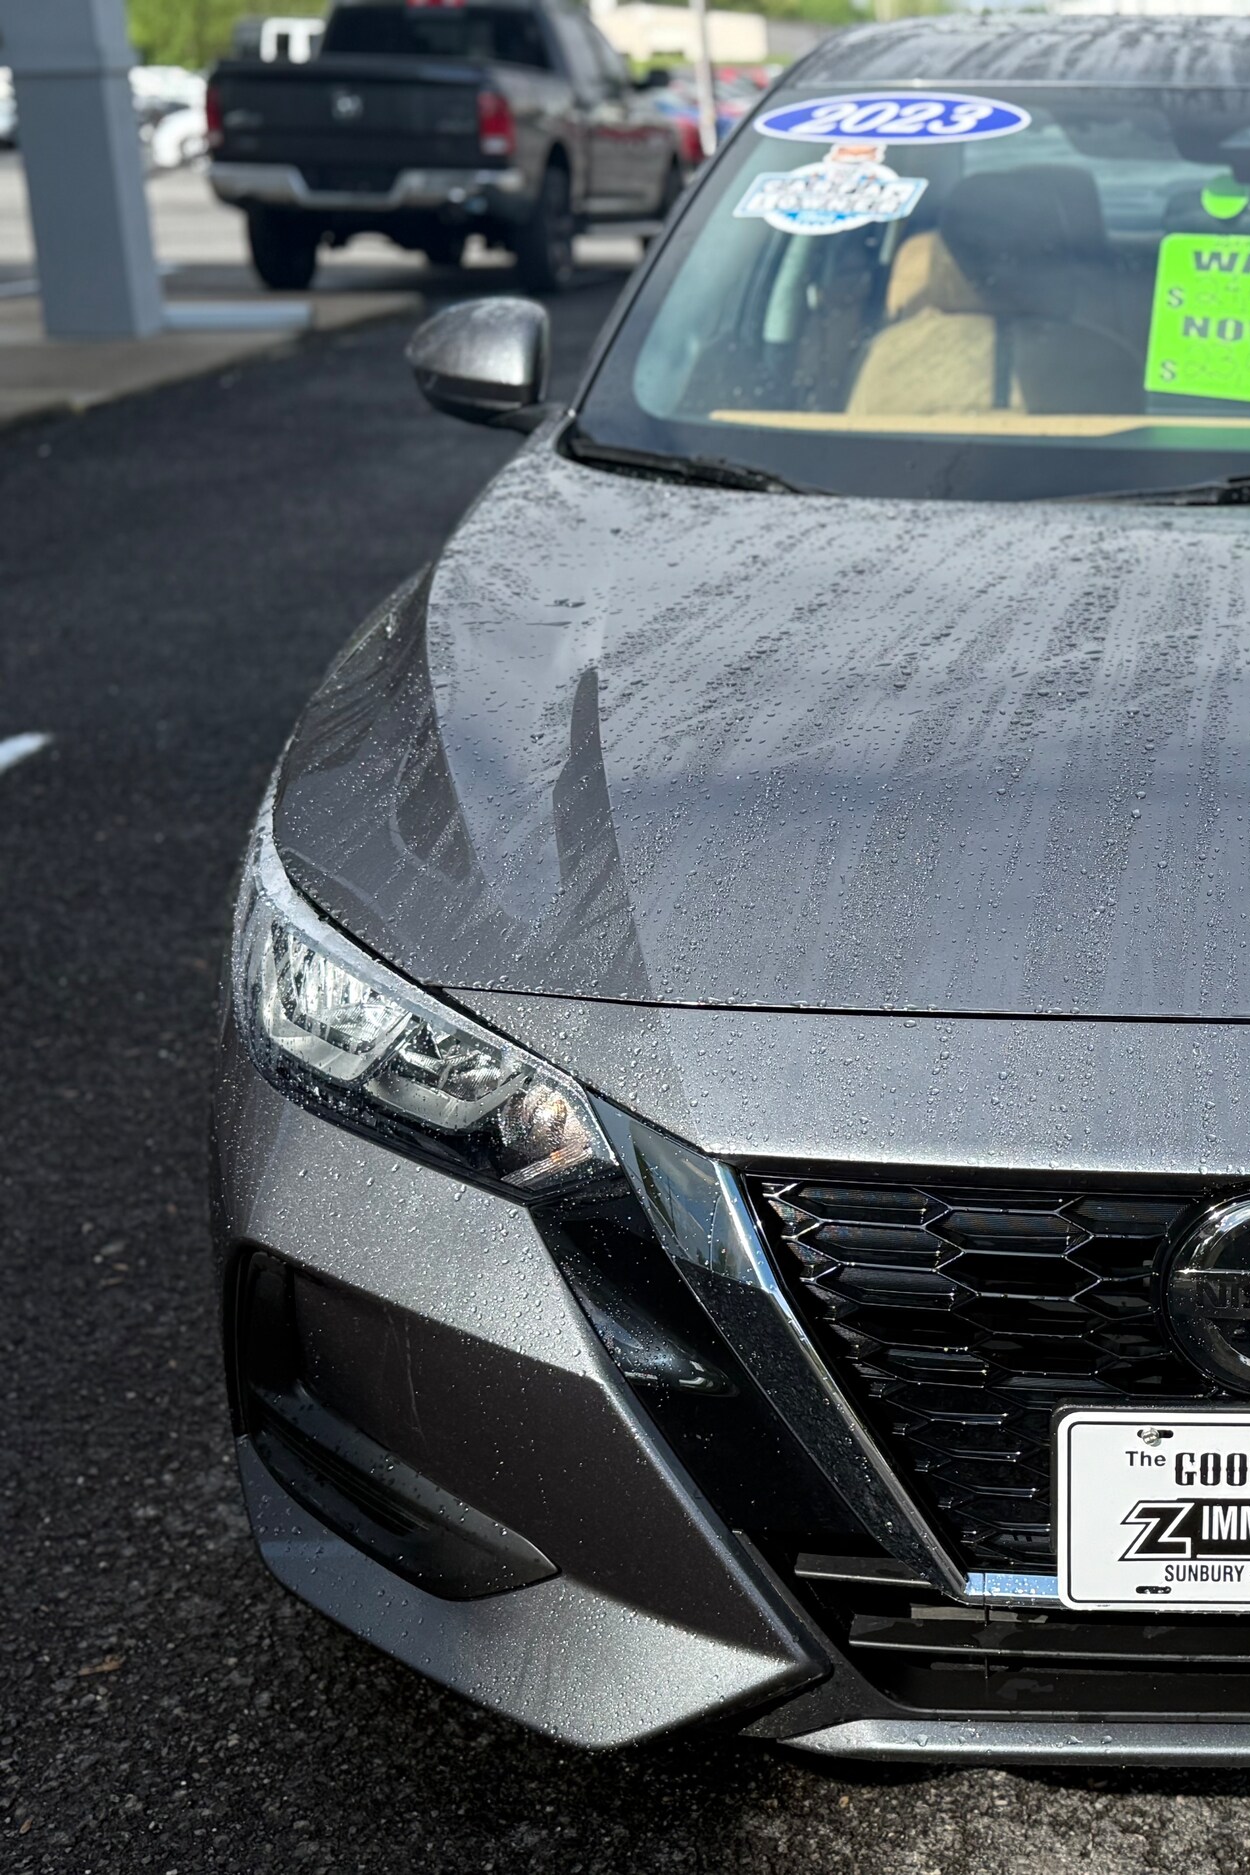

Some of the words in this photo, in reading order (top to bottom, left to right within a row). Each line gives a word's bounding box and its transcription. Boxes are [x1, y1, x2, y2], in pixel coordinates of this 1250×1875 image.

[788, 101, 994, 135] 2023
[1125, 1451, 1167, 1467] The
[1164, 1564, 1245, 1583] SUNBURY
